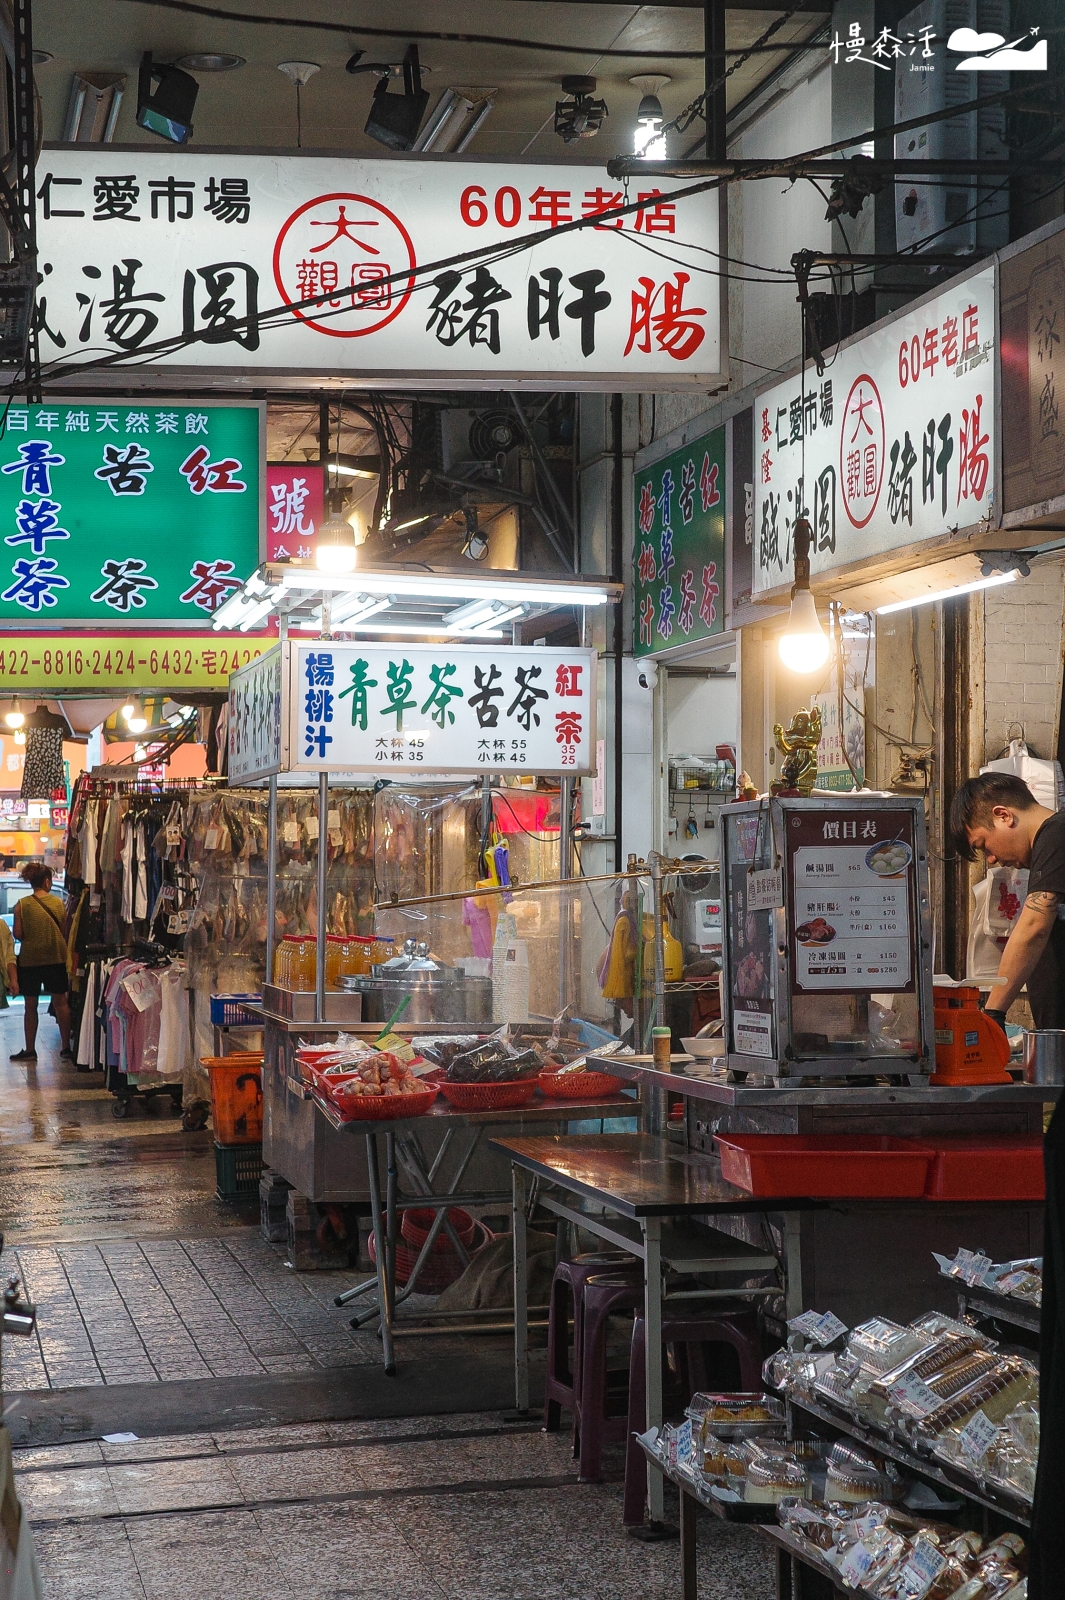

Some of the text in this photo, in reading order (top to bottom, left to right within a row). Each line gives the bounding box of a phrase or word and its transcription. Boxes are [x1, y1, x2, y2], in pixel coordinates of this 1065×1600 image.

[37, 172, 251, 224] 仁愛市場
[460, 185, 676, 233] 60年老店
[309, 205, 380, 255] 大
[425, 266, 707, 360] 豬肝腸
[898, 304, 979, 388] 60年老店
[6, 409, 209, 435] 百年純天然茶飲
[775, 379, 833, 452] 仁愛市場
[851, 388, 873, 444] 大
[761, 408, 773, 484] 基隆
[887, 394, 989, 526] 豬肝腸
[1, 439, 70, 611] 青草茶
[269, 477, 315, 536] 號
[638, 480, 655, 648] 楊桃汁
[657, 469, 675, 640] 青草茶
[304, 652, 334, 758] 楊桃汁
[338, 657, 549, 732] 青草茶 苦茶
[555, 663, 582, 744] 紅茶
[375, 751, 424, 761] 小杯 35
[409, 738, 425, 748] 45
[477, 739, 527, 750] 大杯 55
[477, 752, 526, 763] 小杯 45
[561, 745, 576, 754] 35
[561, 755, 576, 765] 25
[822, 820, 878, 839] 價目表
[808, 951, 846, 961] 冷凍湯圓
[880, 966, 898, 974] $280
